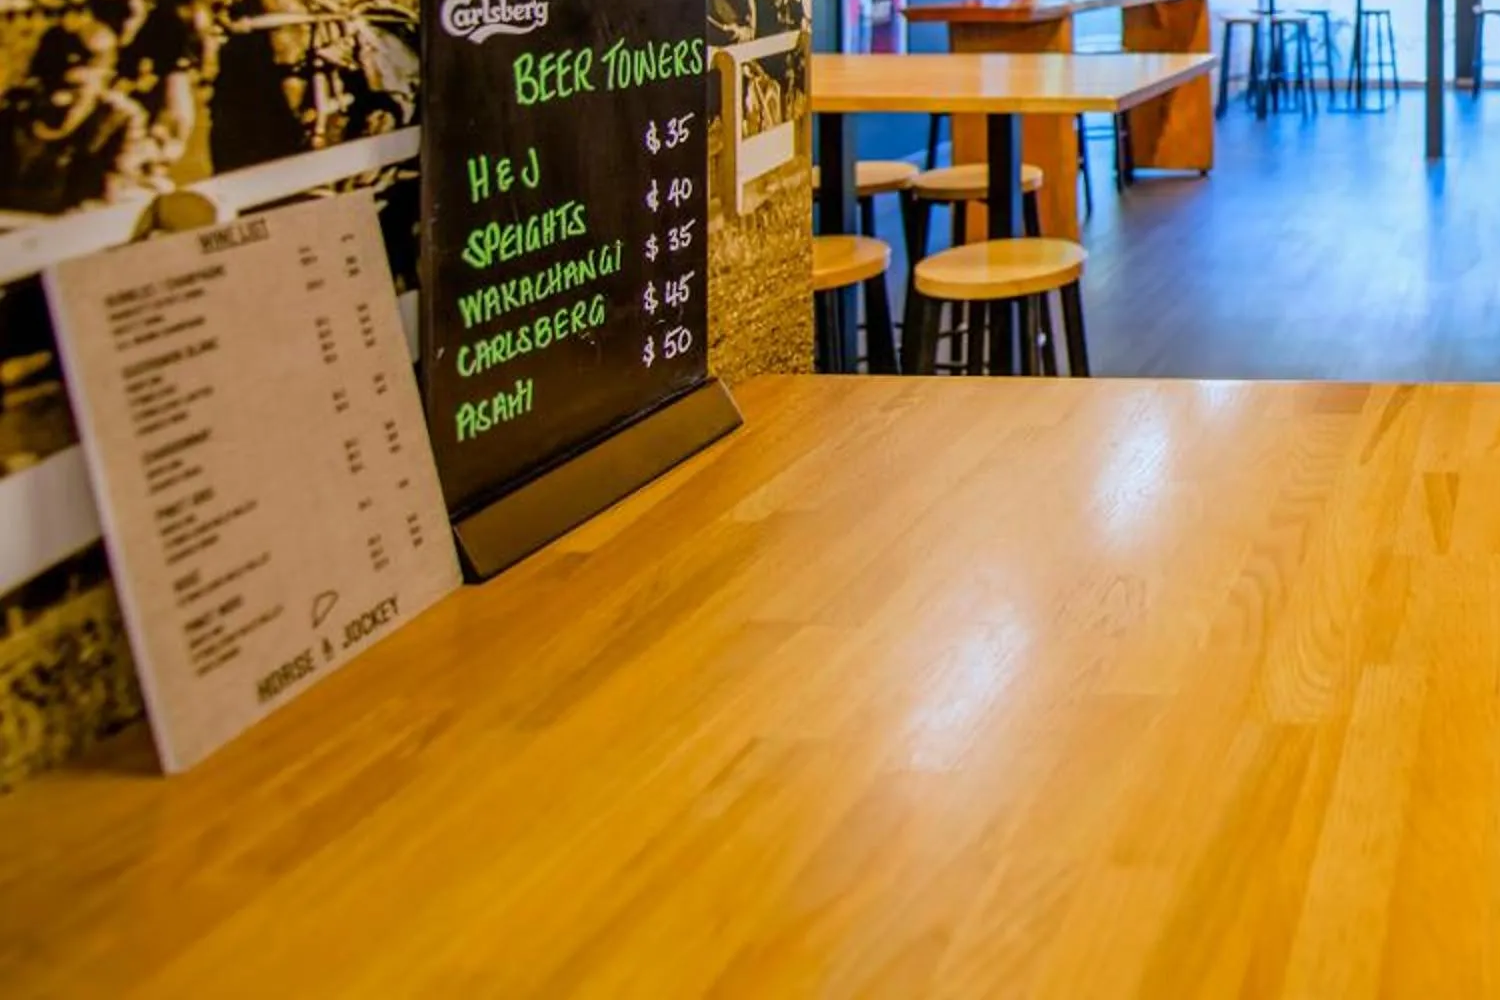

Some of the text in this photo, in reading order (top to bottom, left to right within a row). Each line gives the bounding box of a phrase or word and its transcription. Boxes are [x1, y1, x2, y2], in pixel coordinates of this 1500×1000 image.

[513, 37, 704, 105] BEER TOWERS
[461, 200, 587, 269] SPEIGHTS
[457, 293, 605, 377] CARLSBERG
[455, 378, 534, 442] ASAHI
[256, 648, 316, 704] HORSE
[342, 593, 399, 649] JOCKEY
